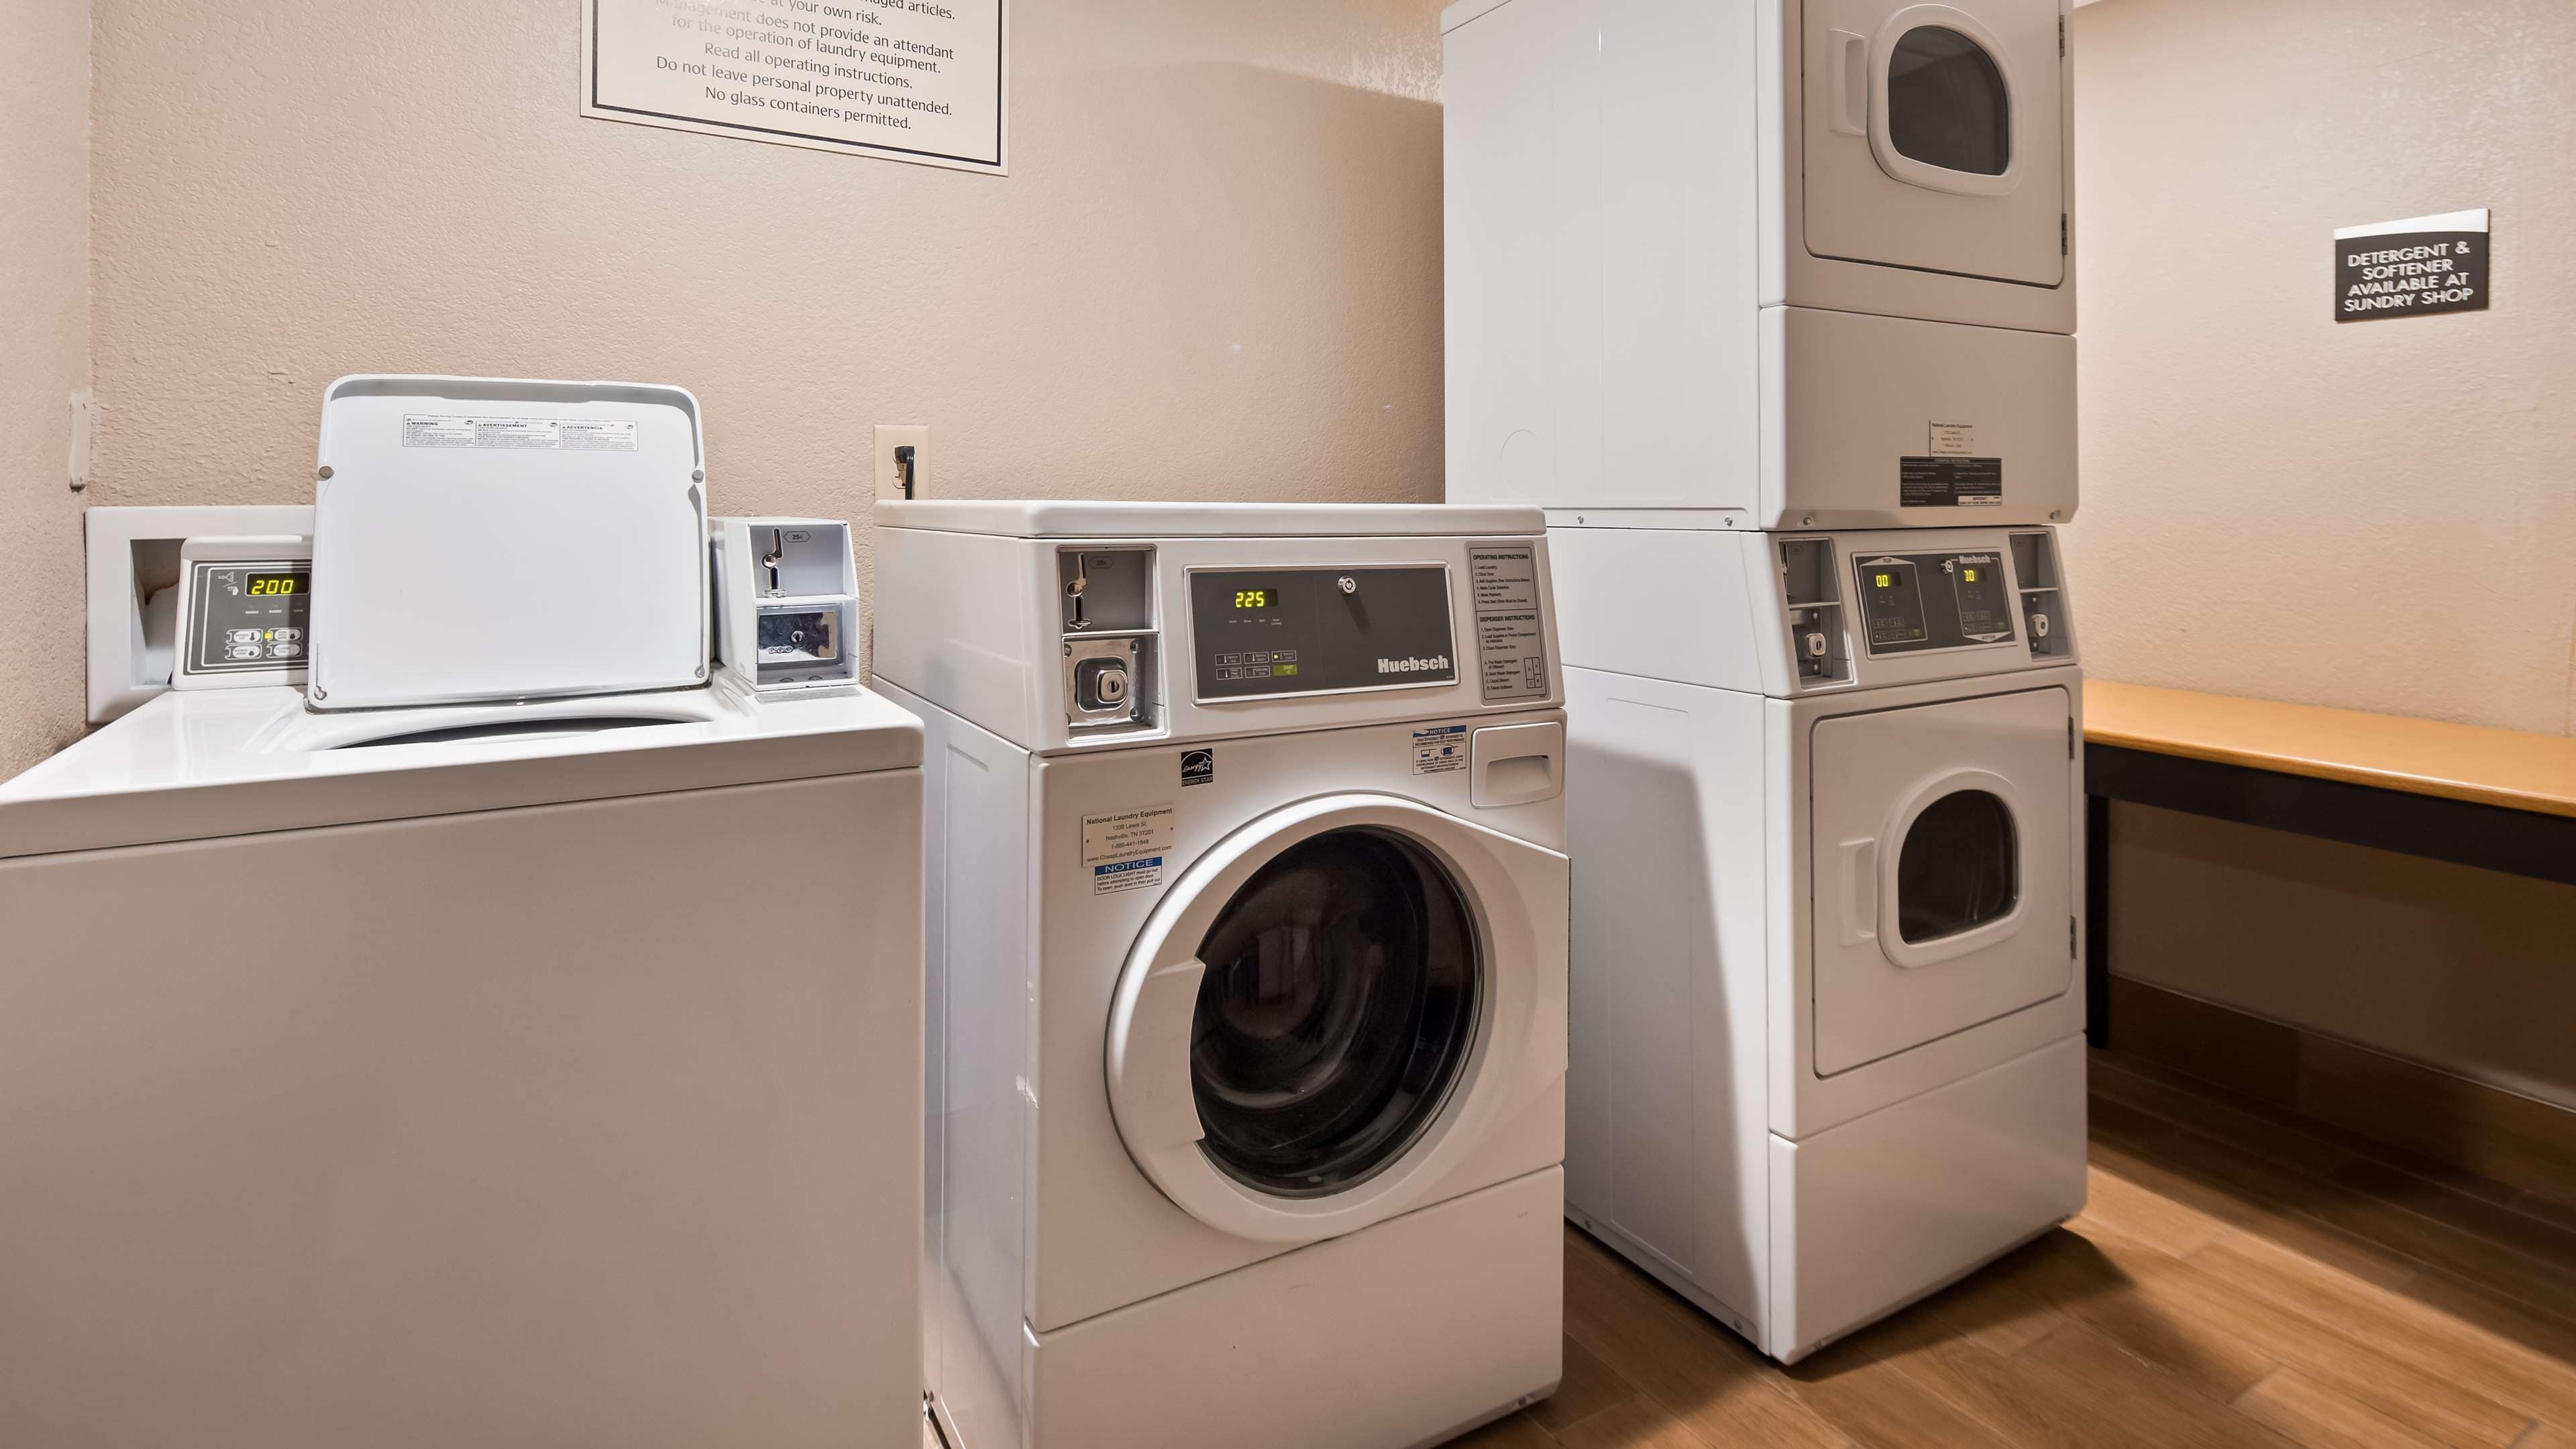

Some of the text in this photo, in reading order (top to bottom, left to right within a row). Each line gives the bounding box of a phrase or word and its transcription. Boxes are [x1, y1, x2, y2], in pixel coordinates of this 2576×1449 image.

[790, 0, 819, 13] your
[824, 6, 851, 19] own
[856, 10, 881, 25] risk.
[908, 3, 955, 19] articles.
[672, 15, 941, 73] for the operation of laundry equipment.
[756, 13, 788, 29] does
[794, 20, 816, 34] not
[821, 25, 869, 44] provide
[874, 36, 888, 47] an
[893, 38, 954, 60] attendant
[705, 42, 912, 89] Read all operating instructions.
[657, 56, 952, 115] Do not leave personal property unattended.
[706, 87, 910, 129] No glass containers permitted.
[2348, 241, 2471, 267] DETERGENT &
[2363, 259, 2453, 280] SOFTENER
[2348, 272, 2470, 297] AVAILABLE AT
[2344, 288, 2473, 312] SUNDRY SHOP
[1959, 555, 1991, 564] Huebsch
[252, 580, 293, 594] 200
[1235, 592, 1265, 608] 225
[1377, 655, 1449, 673] Huebsch
[1087, 808, 1172, 824] National Laundry Equipment
[1105, 859, 1154, 873] NOTICE
